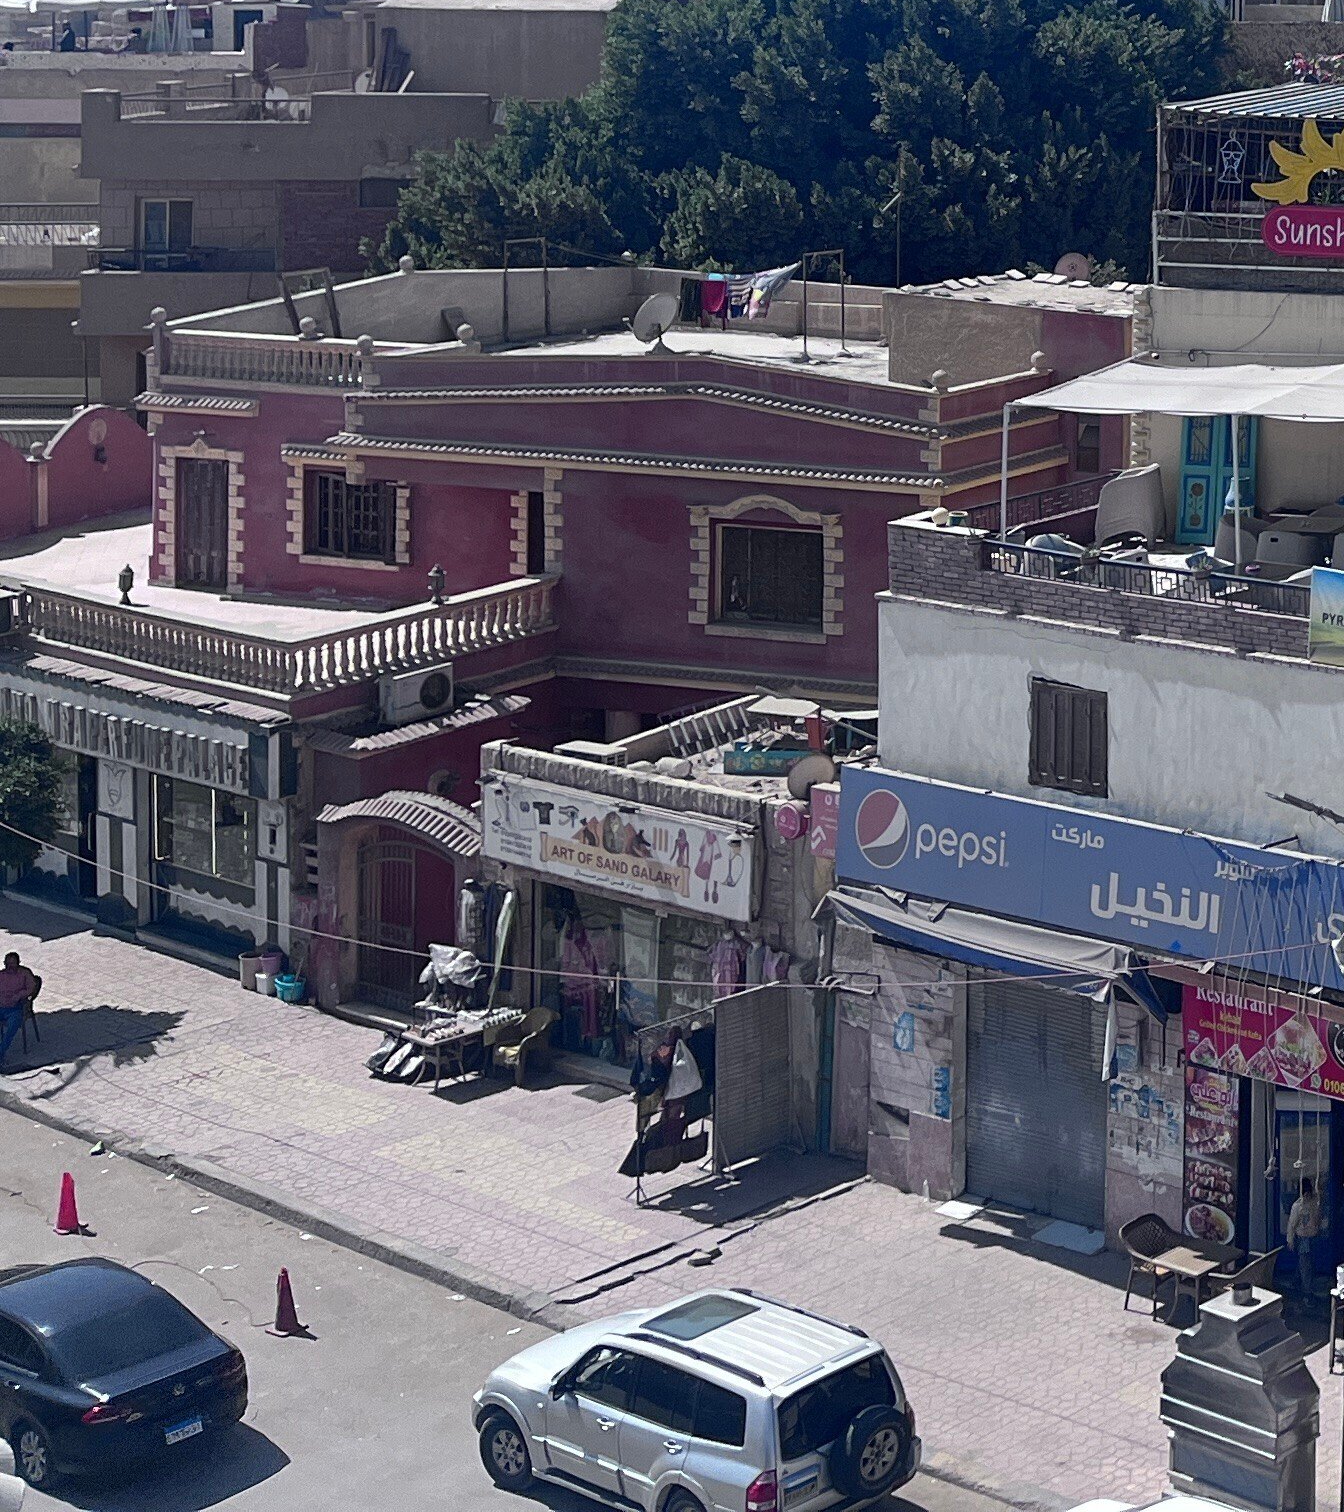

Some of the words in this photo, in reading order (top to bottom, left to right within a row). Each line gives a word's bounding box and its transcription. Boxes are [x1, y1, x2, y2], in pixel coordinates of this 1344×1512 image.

[915, 823, 1006, 868] pepsi
[1052, 823, 1105, 849] ماركت
[551, 844, 574, 864] ART
[577, 850, 593, 867] OF
[596, 855, 627, 874] SAND
[631, 864, 681, 890] GALARY
[1090, 872, 1221, 934] النخيل
[1197, 985, 1275, 1017] Restaurant
